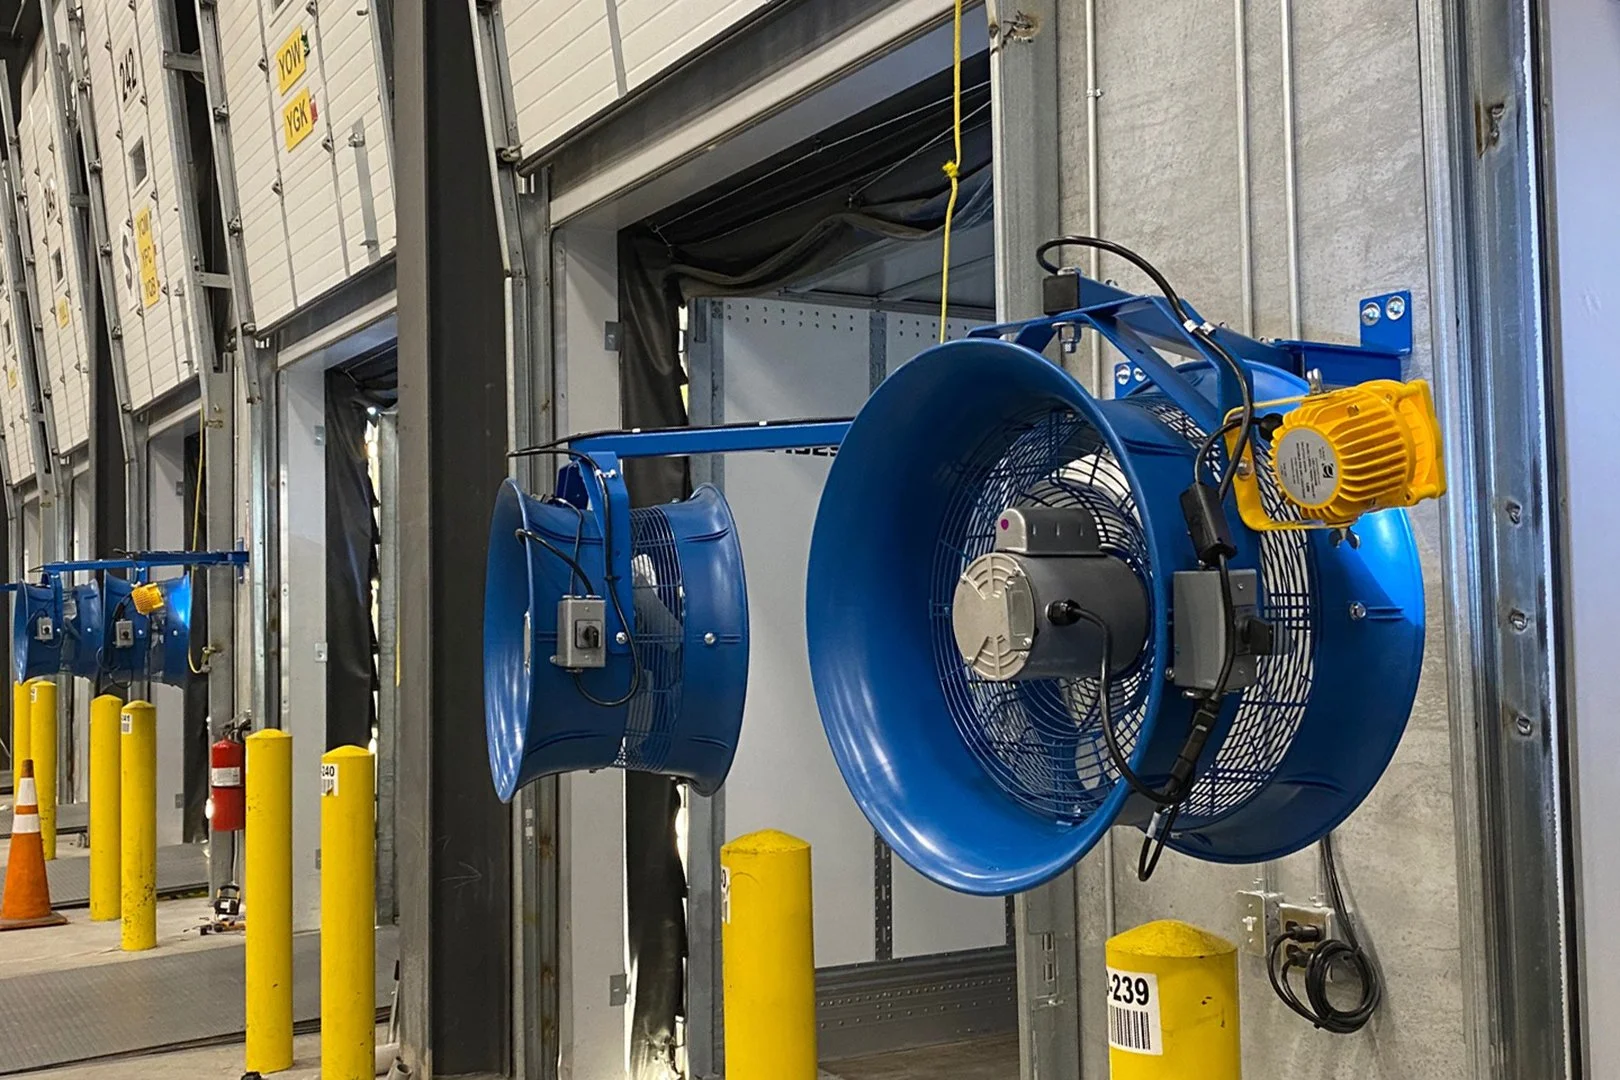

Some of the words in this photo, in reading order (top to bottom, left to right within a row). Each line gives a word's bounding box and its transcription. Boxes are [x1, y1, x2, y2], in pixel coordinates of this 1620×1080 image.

[119, 47, 137, 103] 242
[278, 37, 302, 81] YOW
[286, 98, 308, 139] YGK
[1106, 970, 1149, 1006] -239
